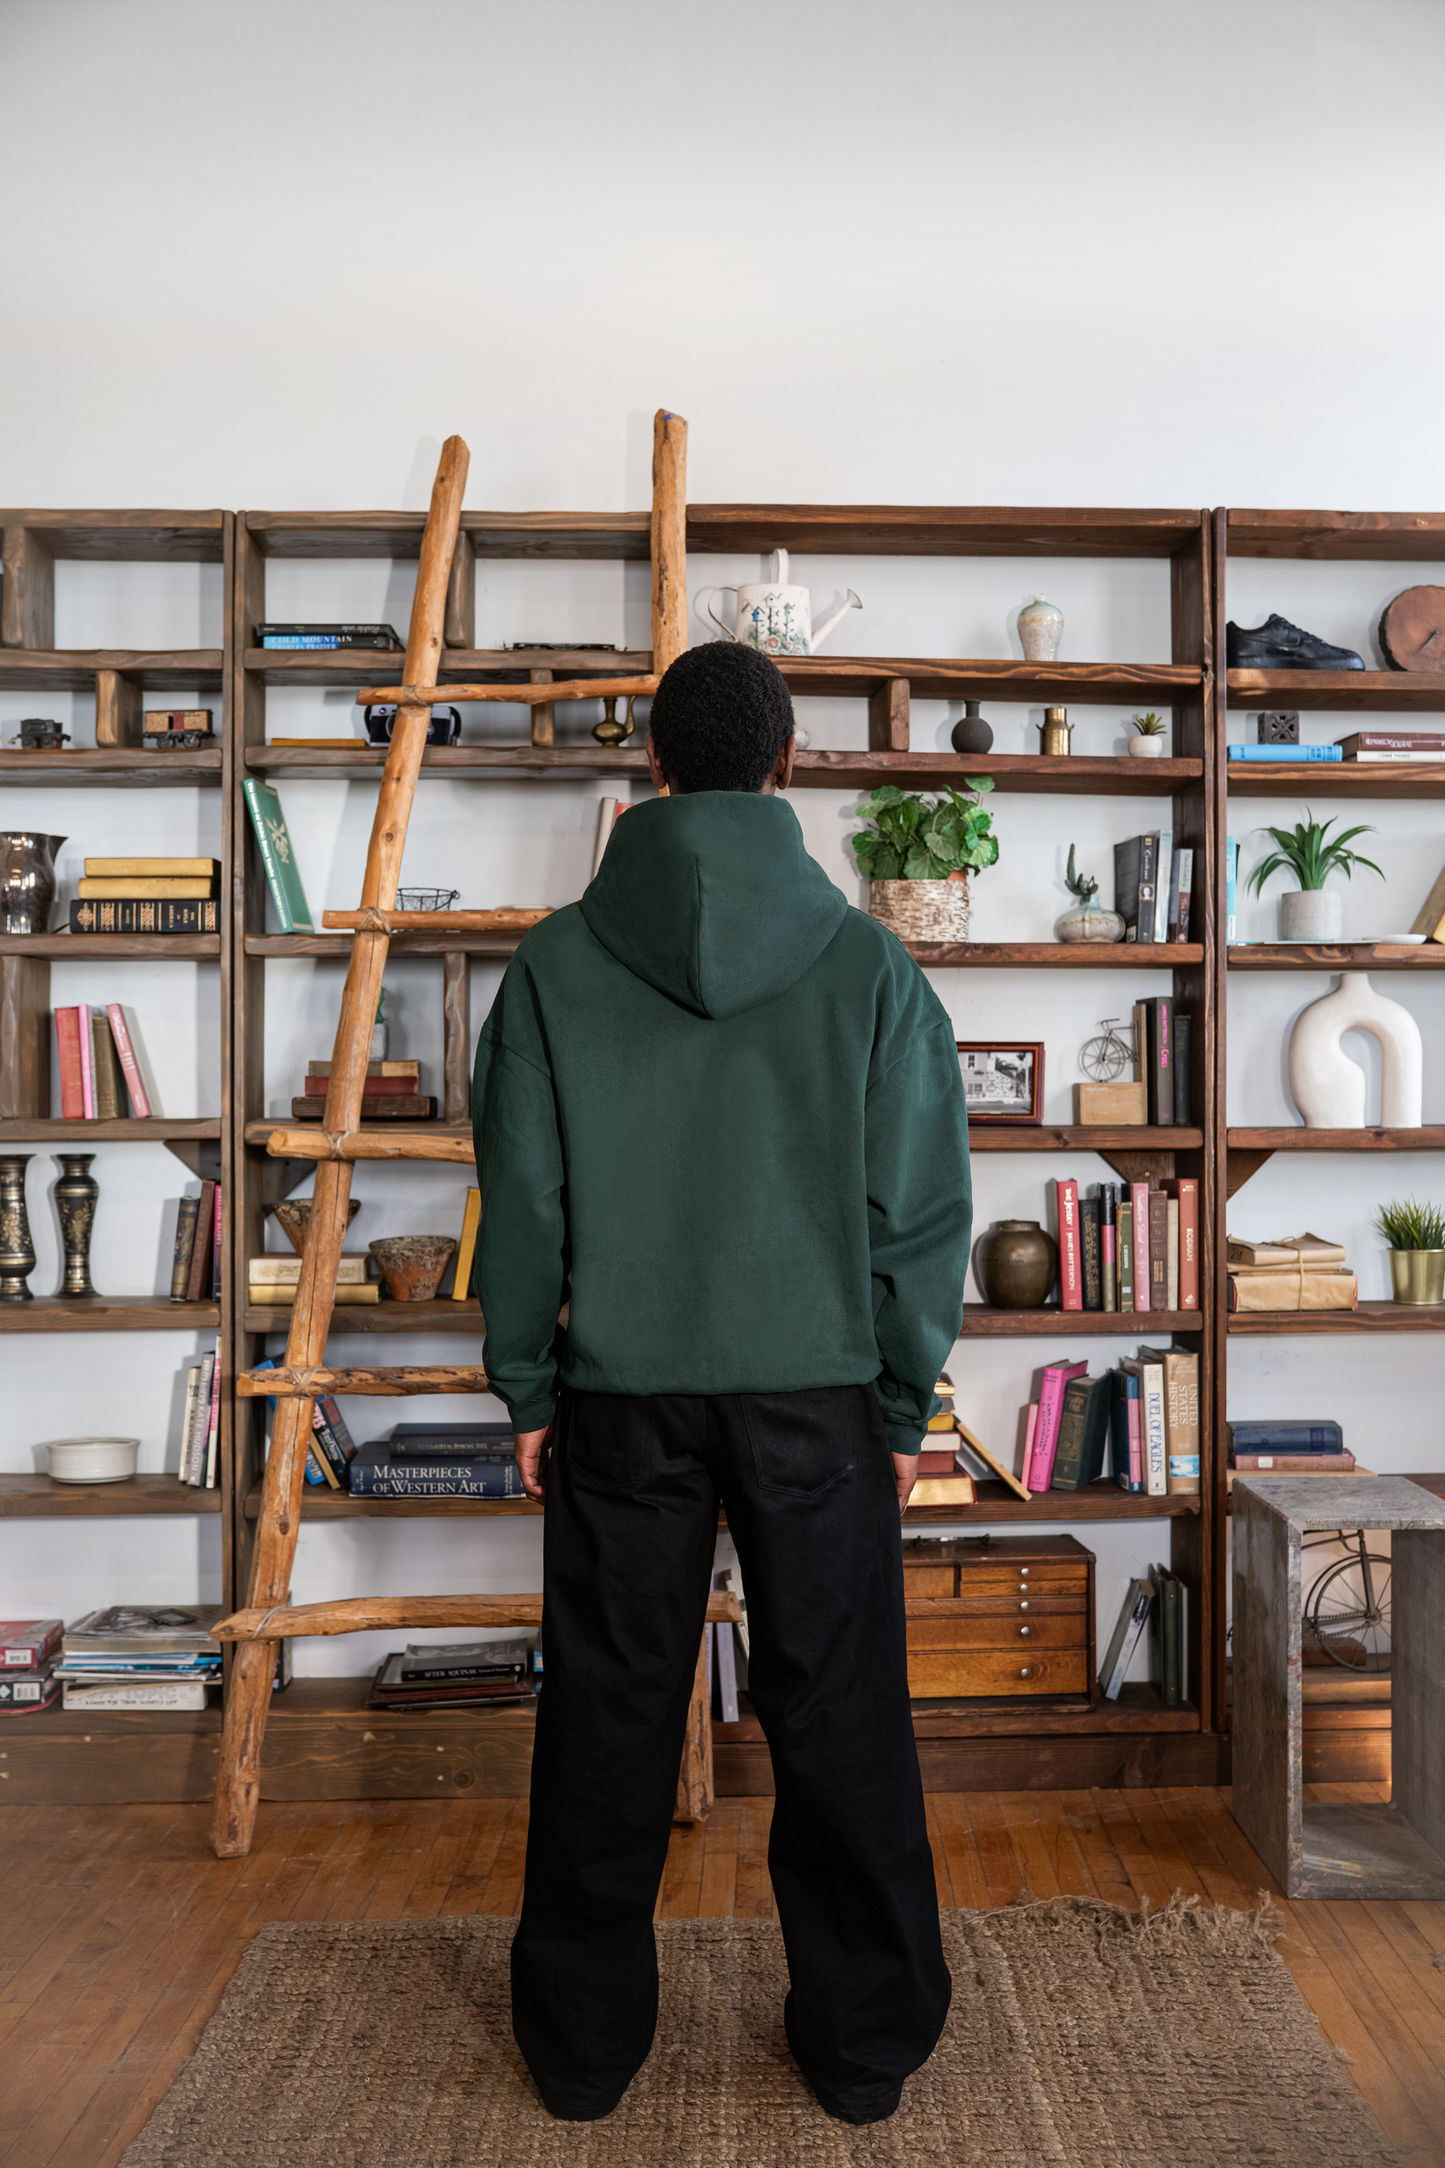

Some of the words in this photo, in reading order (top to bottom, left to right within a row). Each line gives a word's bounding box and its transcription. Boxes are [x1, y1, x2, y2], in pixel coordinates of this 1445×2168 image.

[271, 636, 300, 644] COLD
[301, 635, 353, 644] MOUNTAIN
[1064, 1200, 1074, 1226] Jester
[1066, 1232, 1074, 1252] JAMES
[1186, 1228, 1194, 1262] RODHAM
[195, 1404, 206, 1428] KATE
[1148, 1392, 1160, 1418] DUEL
[1168, 1382, 1178, 1429] HISTORY
[1179, 1384, 1188, 1425] STATES
[1188, 1383, 1198, 1426] UNITED
[1150, 1420, 1162, 1434] OF
[190, 1430, 202, 1471] HUDSON
[1150, 1434, 1162, 1474] EAGLES
[373, 1465, 472, 1479] MASTERPIECES
[372, 1482, 390, 1494] OF
[390, 1480, 456, 1494] WESTERN
[458, 1480, 487, 1494] ART
[448, 1669, 477, 1678] AQUINAS
[125, 1686, 178, 1700] TOPIC
